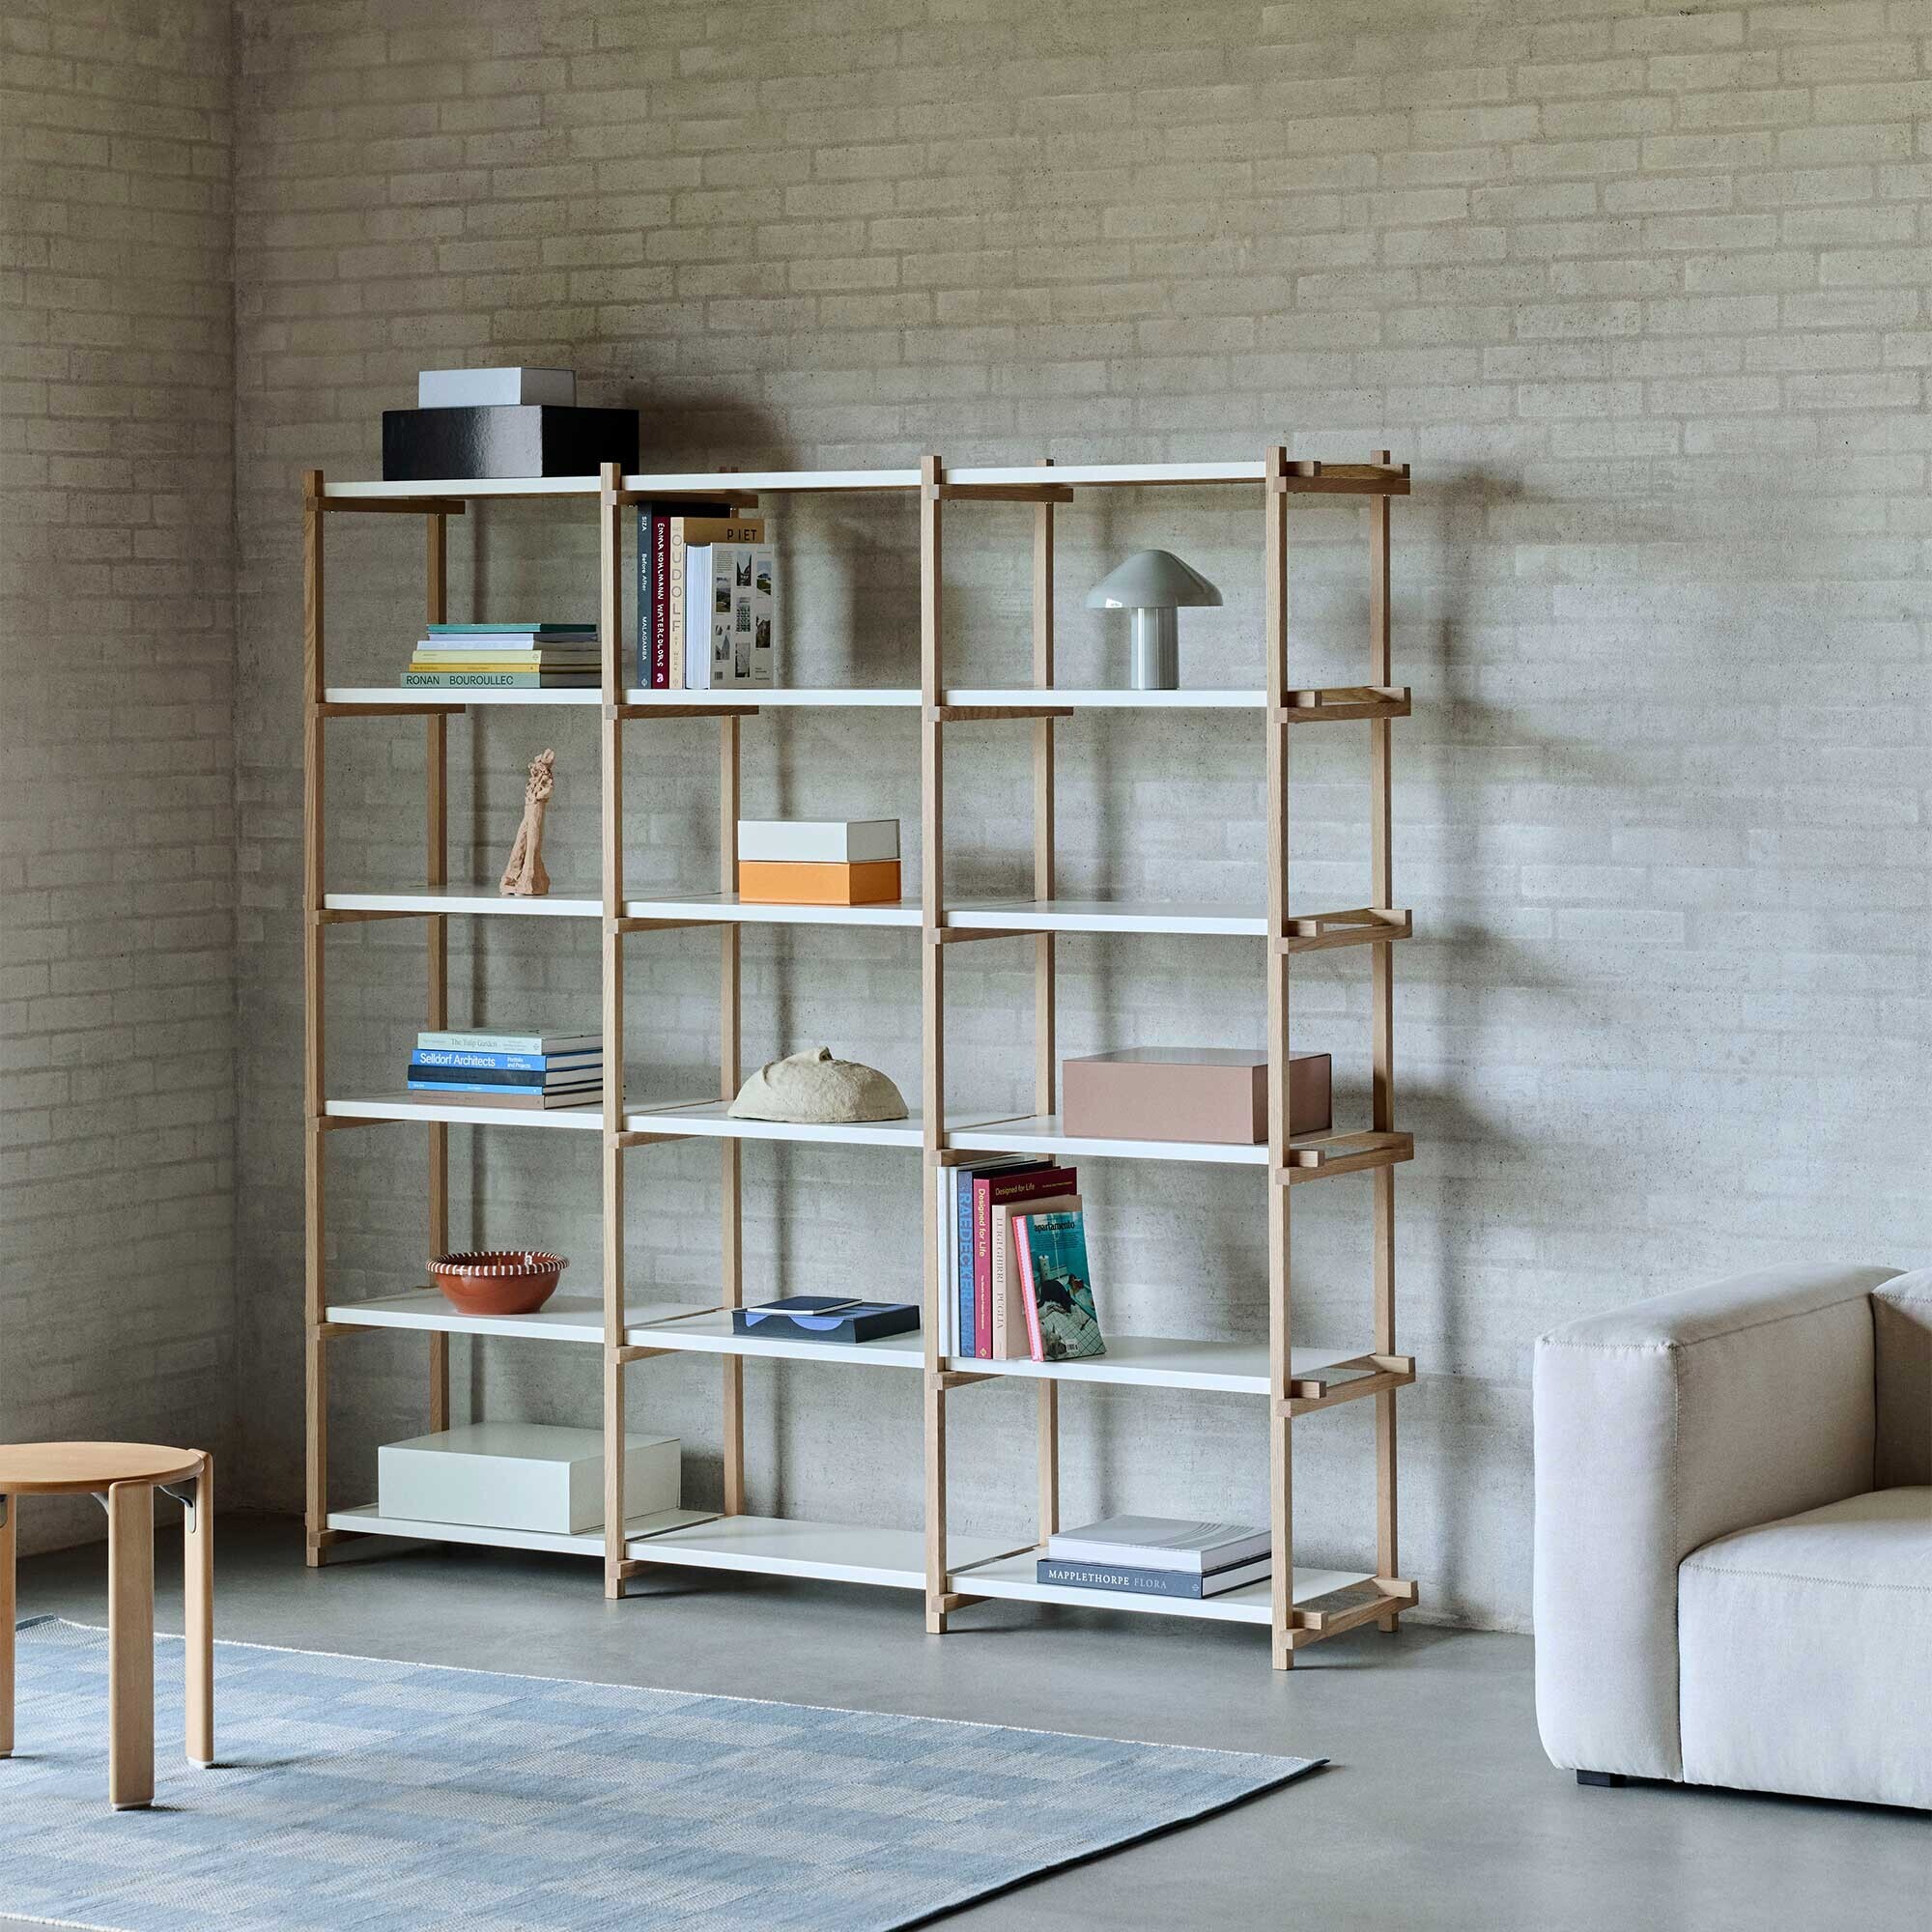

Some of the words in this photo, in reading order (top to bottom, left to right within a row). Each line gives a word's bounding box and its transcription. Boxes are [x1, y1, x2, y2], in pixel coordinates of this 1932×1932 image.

[726, 528, 757, 541] PIET
[672, 534, 682, 632] OUDOLF
[656, 603, 665, 667] WATERCOLORS
[406, 675, 440, 685] RONAN
[449, 675, 514, 685] BOUROULLEC
[419, 1053, 452, 1065] Selldorf
[453, 1054, 496, 1067] Architects
[995, 1185, 1017, 1196] Designed
[1025, 1182, 1036, 1191] Life
[978, 1188, 986, 1226] Designed
[1034, 1220, 1075, 1233] apartamento
[1048, 1569, 1129, 1586] MAPPLETHORPE
[1134, 1577, 1167, 1590] FLORA
